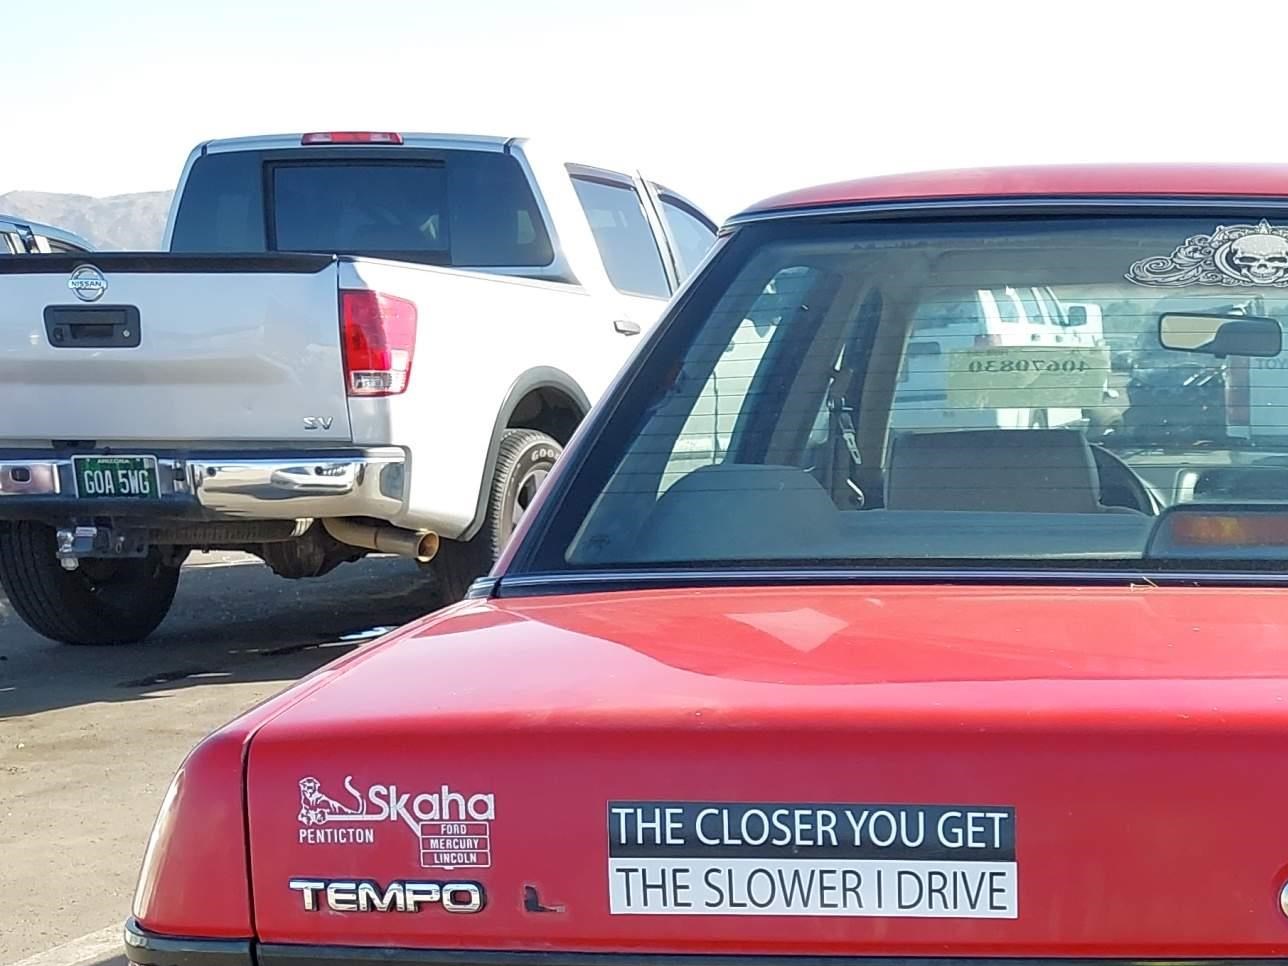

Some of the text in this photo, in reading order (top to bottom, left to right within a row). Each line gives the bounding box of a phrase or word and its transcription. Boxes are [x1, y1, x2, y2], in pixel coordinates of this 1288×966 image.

[71, 279, 103, 288] NISSAN
[303, 416, 333, 430] SV
[368, 784, 496, 822] Skaha
[440, 824, 467, 835] FORD
[612, 807, 1009, 849] THE CLOSER YOU GET
[299, 828, 374, 844] PENTICTON
[429, 838, 480, 849] MERCURY
[433, 852, 477, 864] LINCOLN
[289, 878, 485, 913] TEMPO
[615, 867, 1009, 911] THE SLOWER I DRIVE
